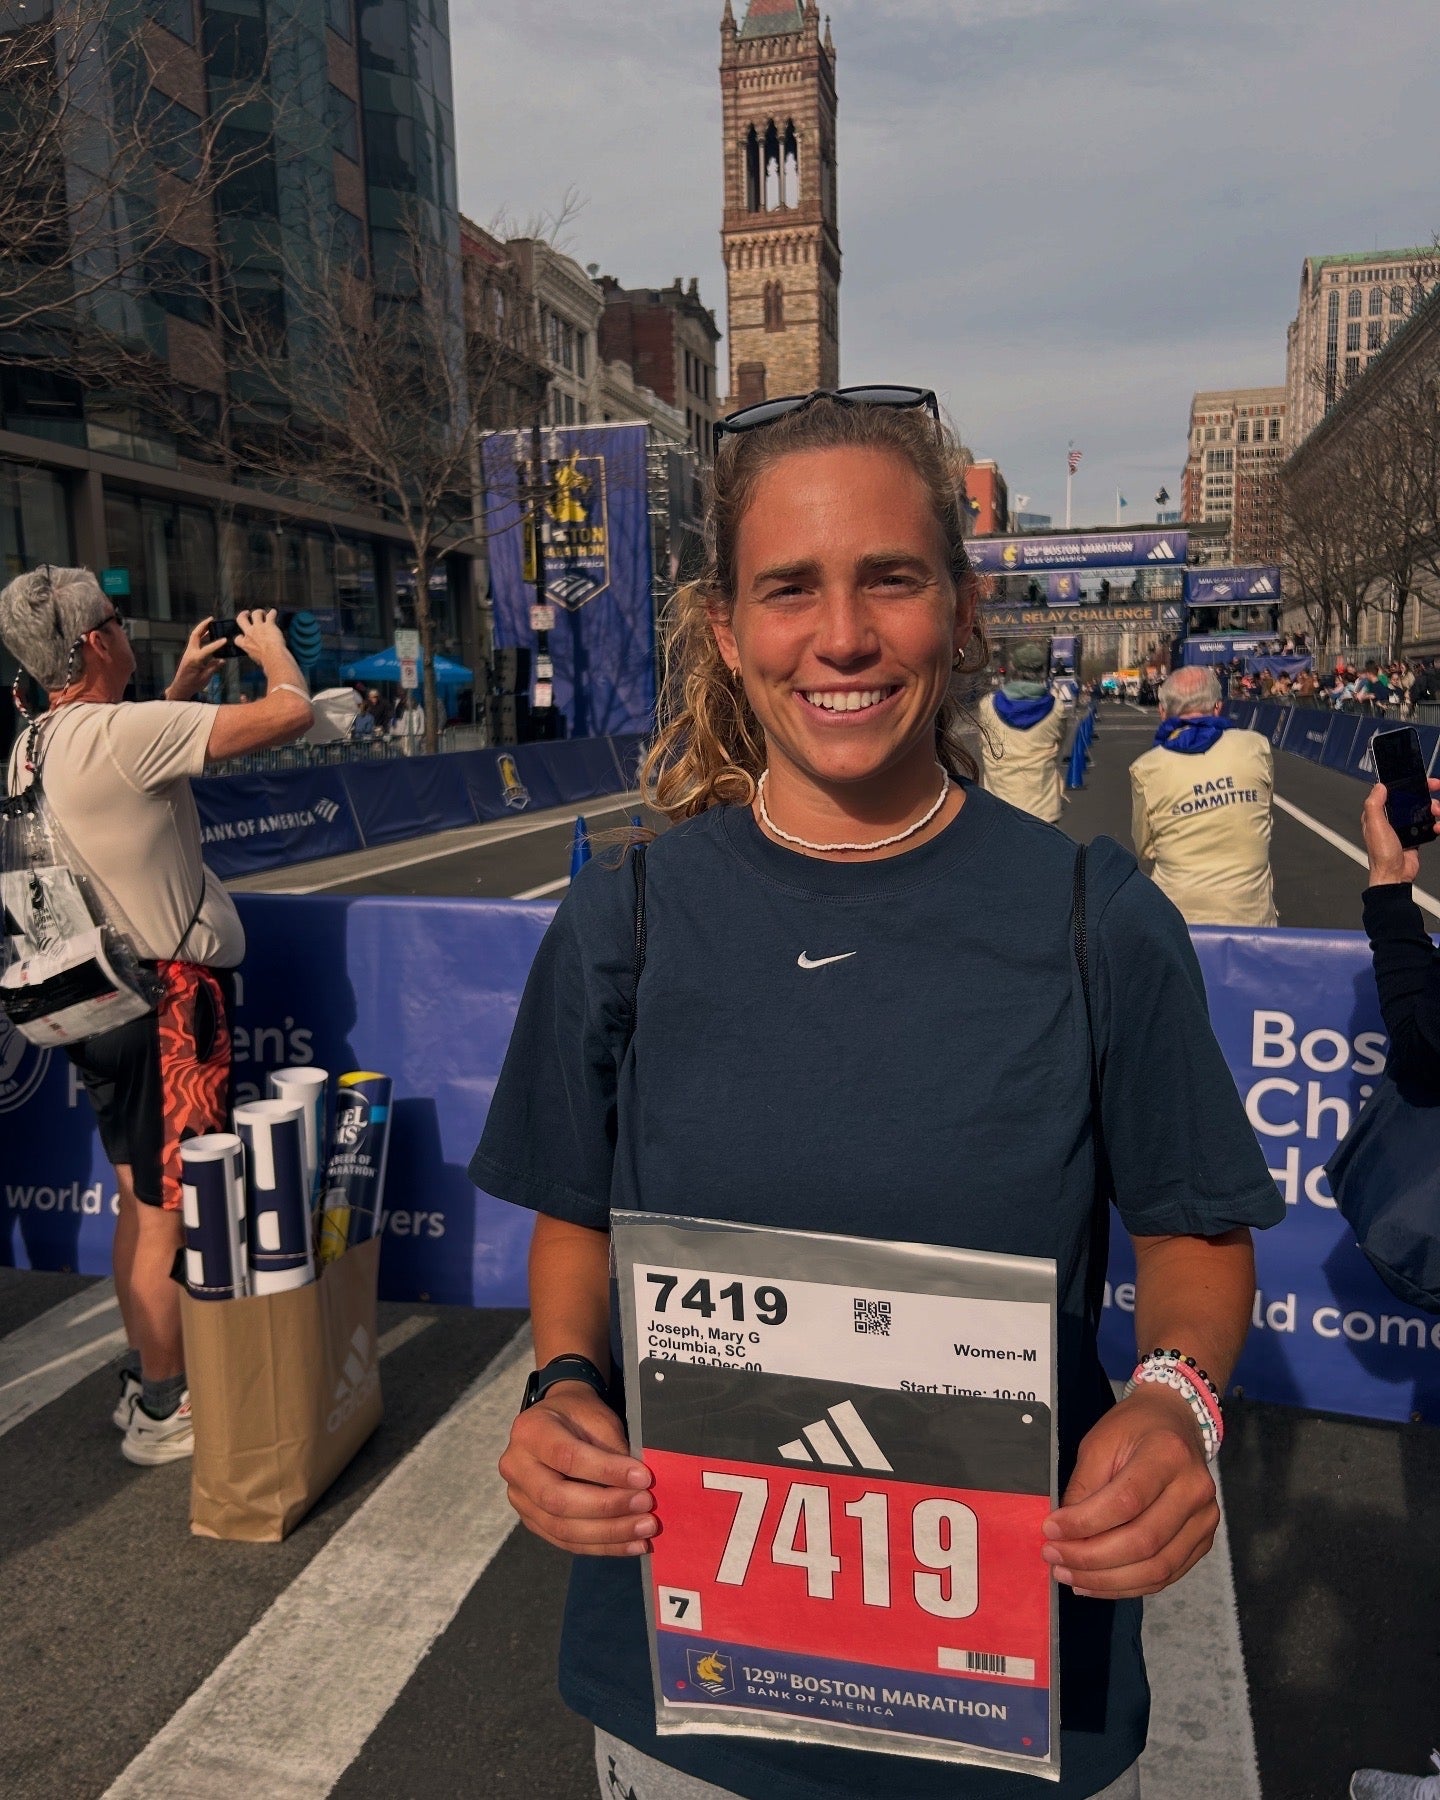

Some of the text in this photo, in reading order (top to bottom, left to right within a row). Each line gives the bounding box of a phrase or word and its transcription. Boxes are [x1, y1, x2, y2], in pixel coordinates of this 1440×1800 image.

[1022, 610, 1068, 624] RELAY
[1068, 606, 1153, 622] CHALLENGE
[1192, 776, 1235, 796] RACE
[237, 818, 255, 838] OF
[259, 810, 316, 834] AMERICA
[1252, 1009, 1387, 1075] Bos
[5, 1180, 103, 1215] world
[646, 1272, 788, 1326] 7419
[647, 1320, 760, 1345] Joseph, Mary G
[648, 1335, 746, 1358] Columbia, SC
[953, 1343, 1037, 1362] Women-M
[900, 1380, 938, 1394] Start
[993, 1389, 1036, 1401] 10:00
[701, 1470, 979, 1620] 7419
[668, 1595, 690, 1619] 7
[742, 1666, 1008, 1721] 129TH BOSTON MARATHON
[747, 1685, 894, 1717] BANK OF AMERICA
